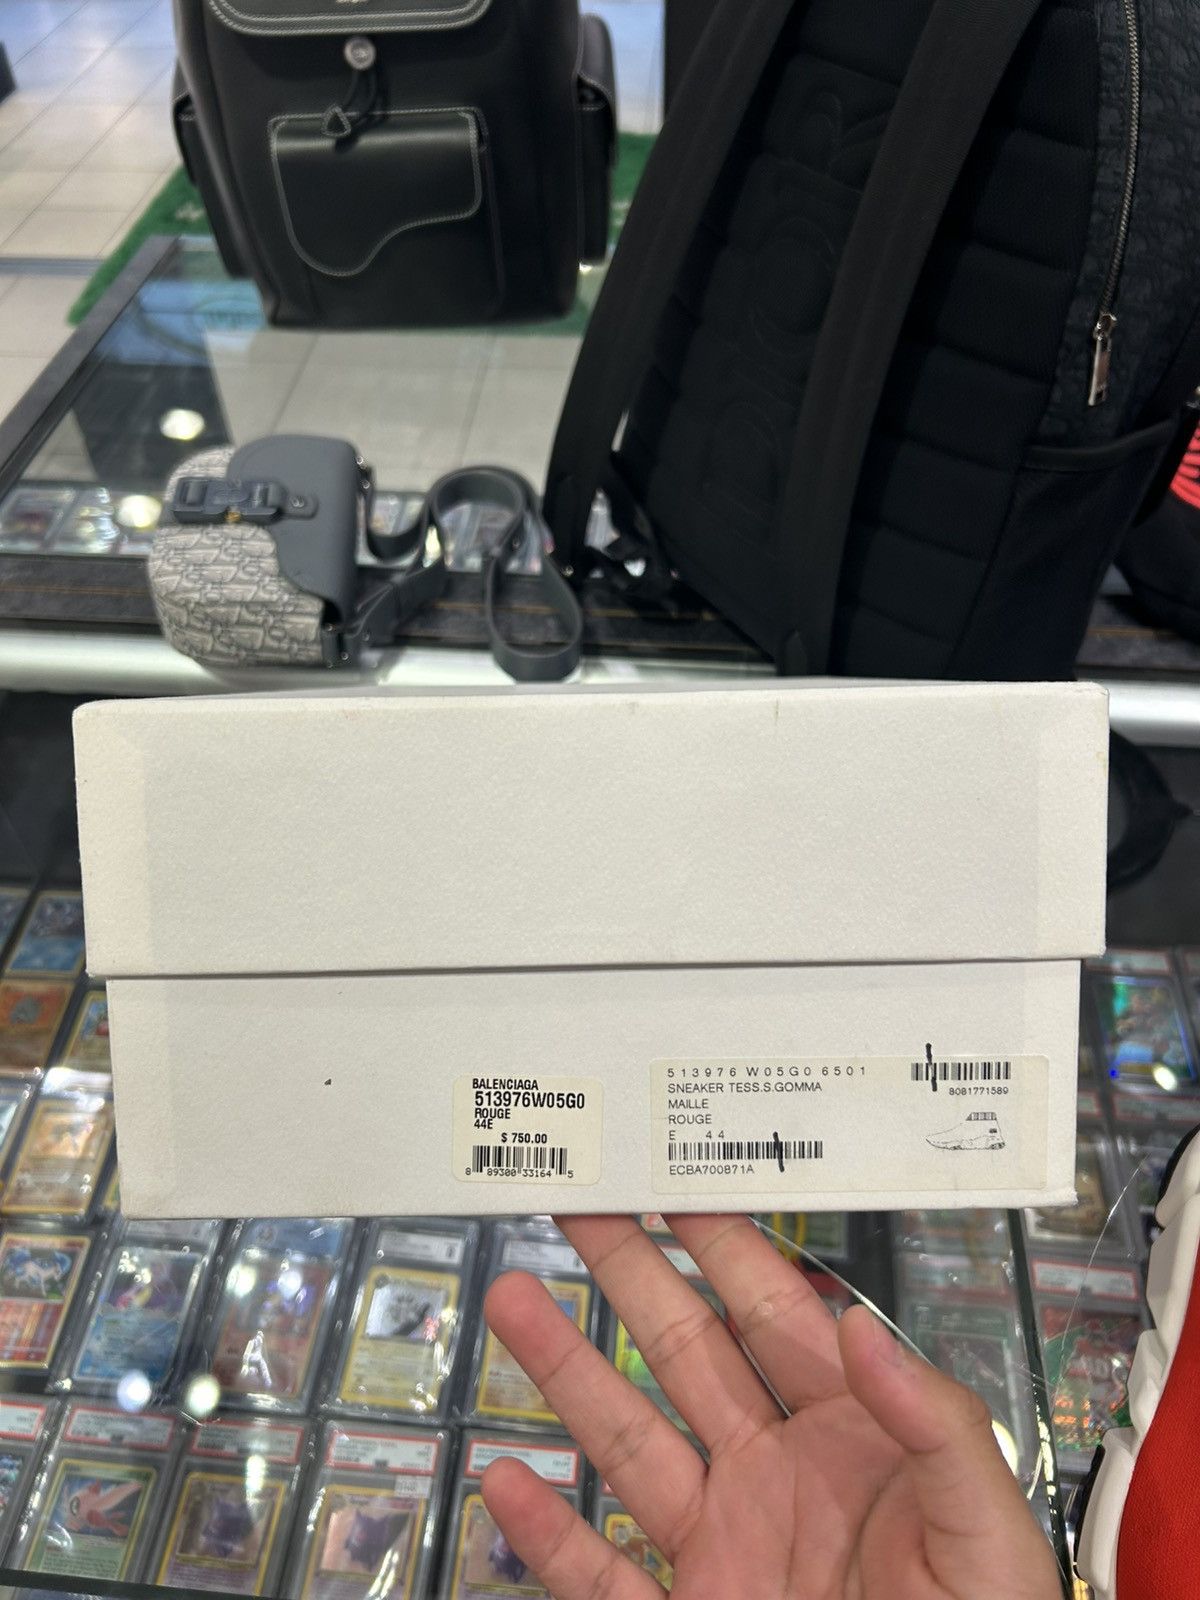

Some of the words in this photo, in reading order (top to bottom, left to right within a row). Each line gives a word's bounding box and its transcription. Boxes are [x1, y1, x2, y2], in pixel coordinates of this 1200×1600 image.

[667, 1067, 737, 1078] 513976
[821, 1065, 865, 1077] 6501
[472, 1078, 539, 1090] BALENCIAGA
[667, 1082, 724, 1093] SNEAKER
[728, 1081, 823, 1093] TESS.S.GOMMA
[948, 1086, 1009, 1096] 8081771589
[474, 1091, 585, 1109] 513976W05G0
[668, 1098, 709, 1109] MAILLE
[474, 1107, 511, 1119] ROUGE
[474, 1118, 493, 1129] 44E
[668, 1114, 712, 1125] ROUGE
[501, 1132, 508, 1143] $
[511, 1133, 548, 1144] 750.00
[668, 1130, 676, 1140] E
[705, 1130, 725, 1140] 44
[465, 1167, 471, 1176] 8
[522, 1168, 552, 1177] 33164
[567, 1170, 574, 1178] 5
[669, 1164, 755, 1176] ECBA700871A
